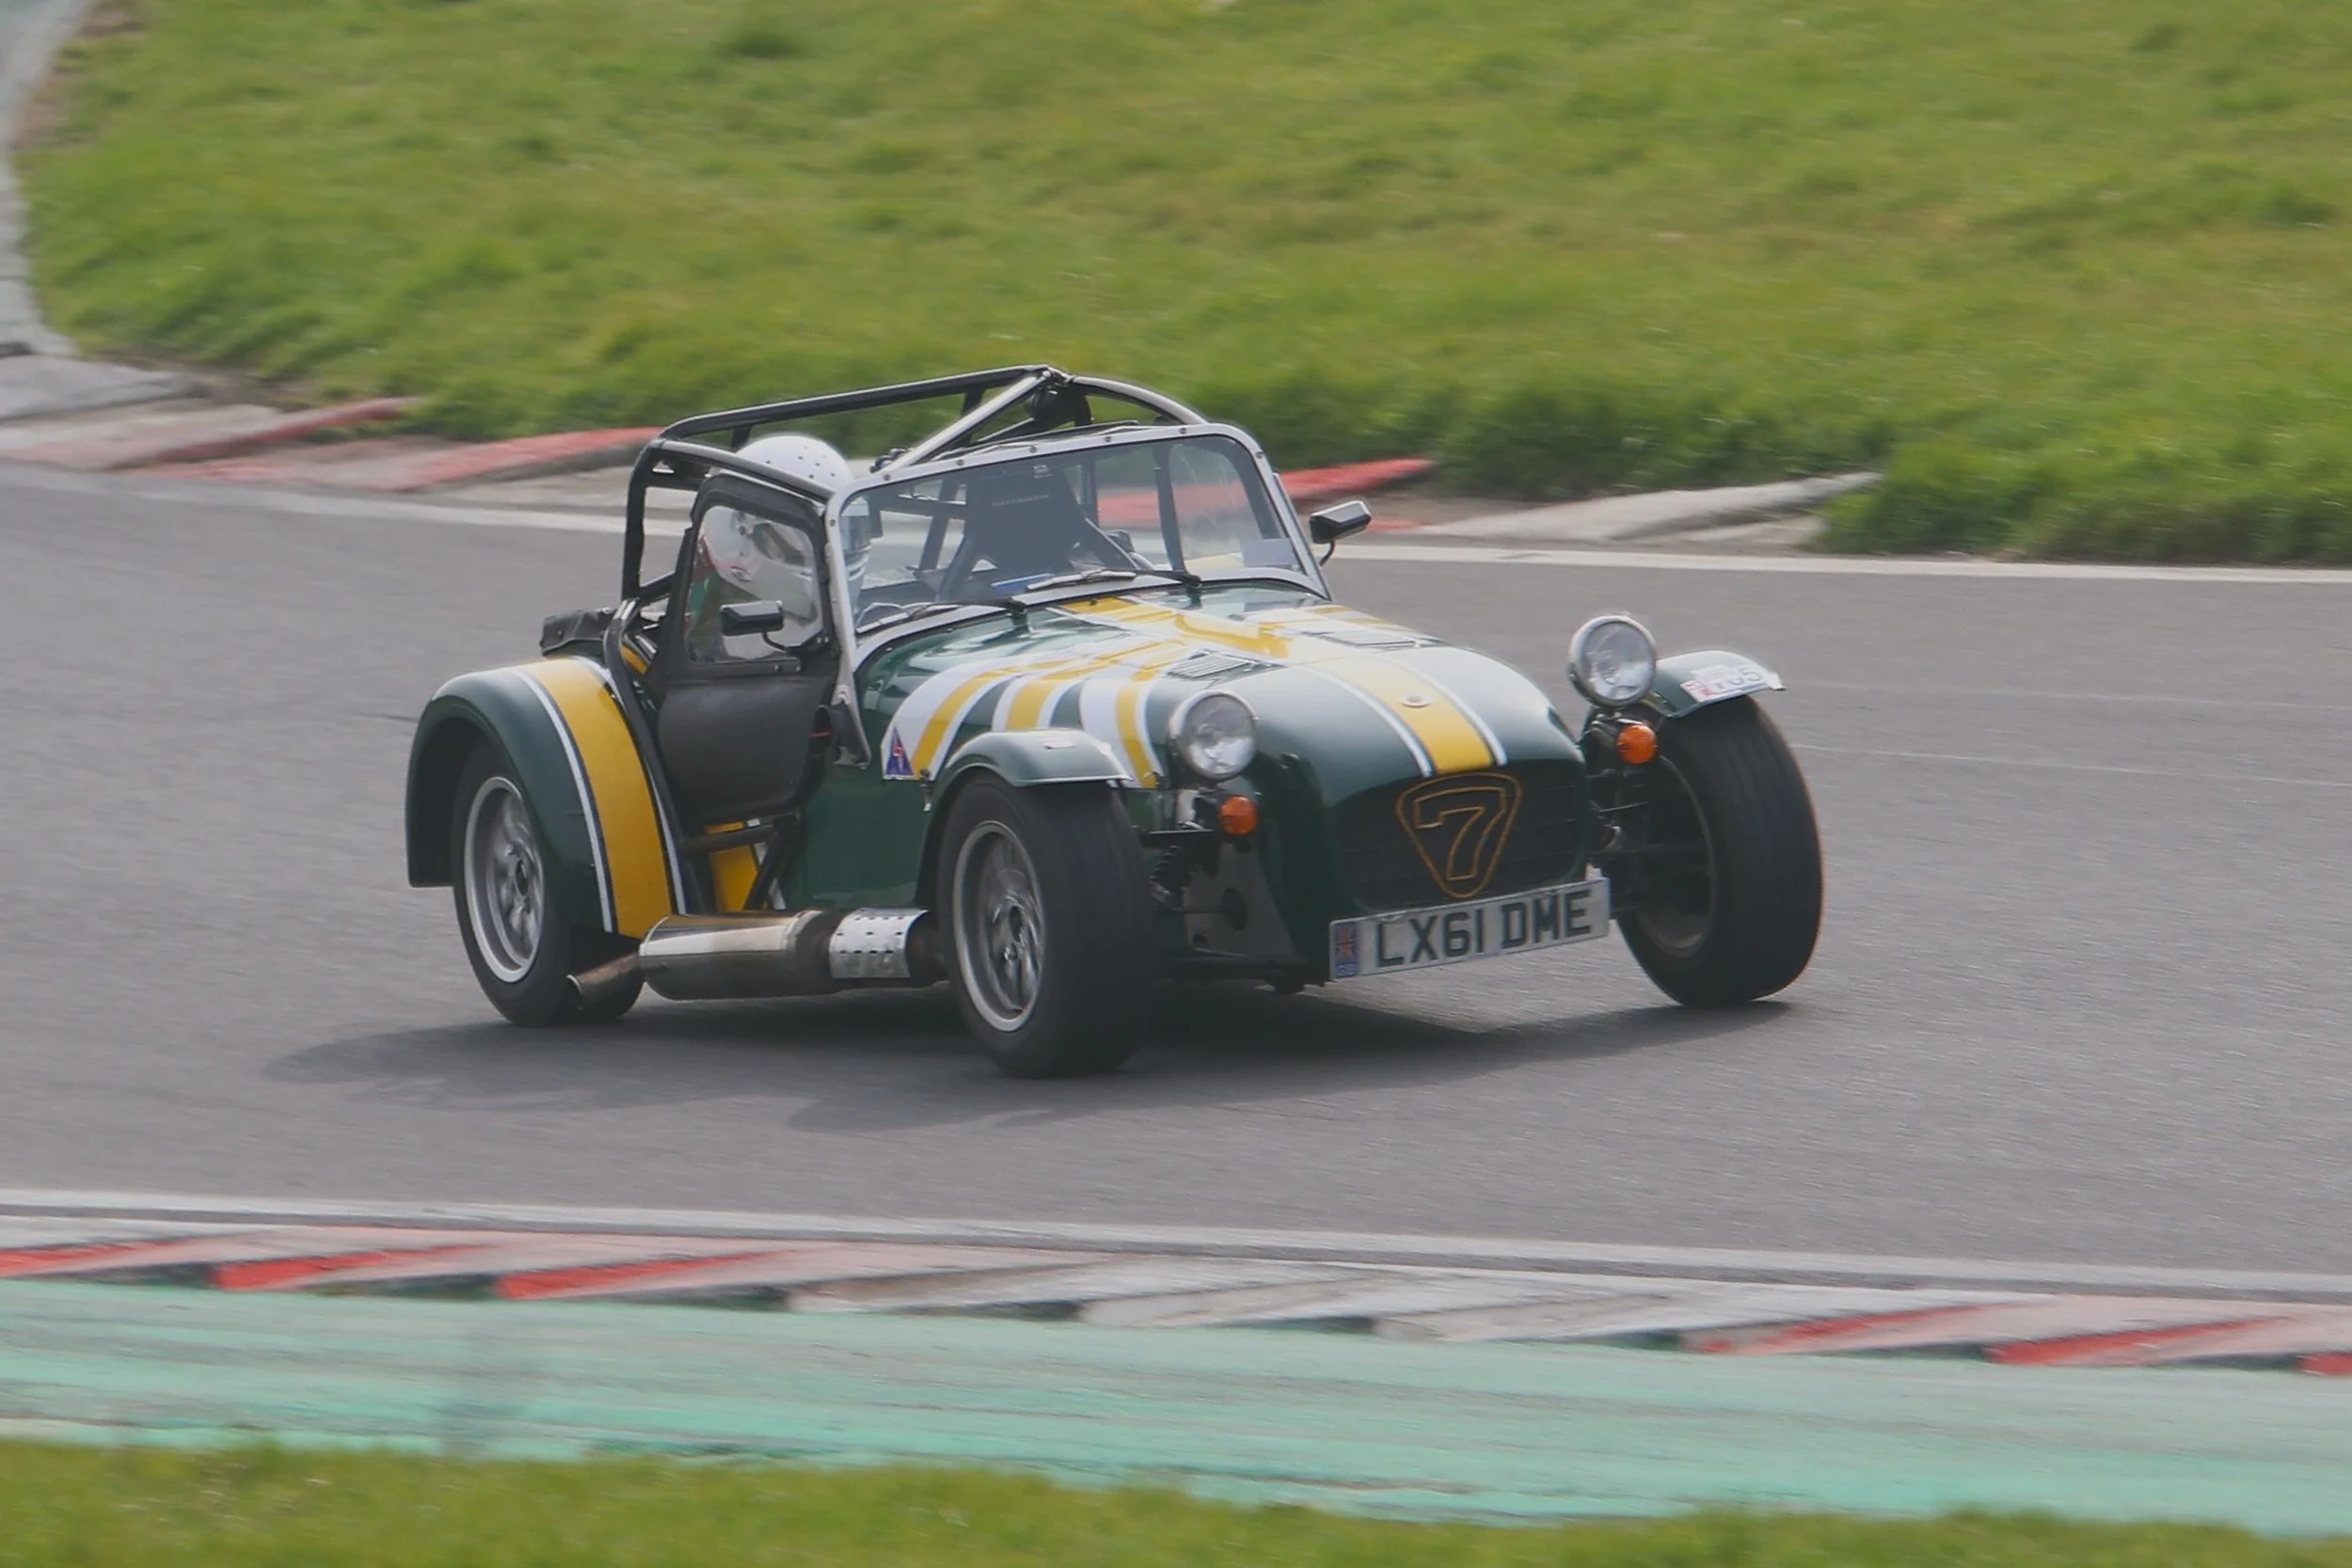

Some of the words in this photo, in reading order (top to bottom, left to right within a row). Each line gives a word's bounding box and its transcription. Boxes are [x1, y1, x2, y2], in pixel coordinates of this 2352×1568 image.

[1413, 786, 1507, 882] 7
[1376, 908, 1484, 968] LX61
[1501, 890, 1592, 949] DME
